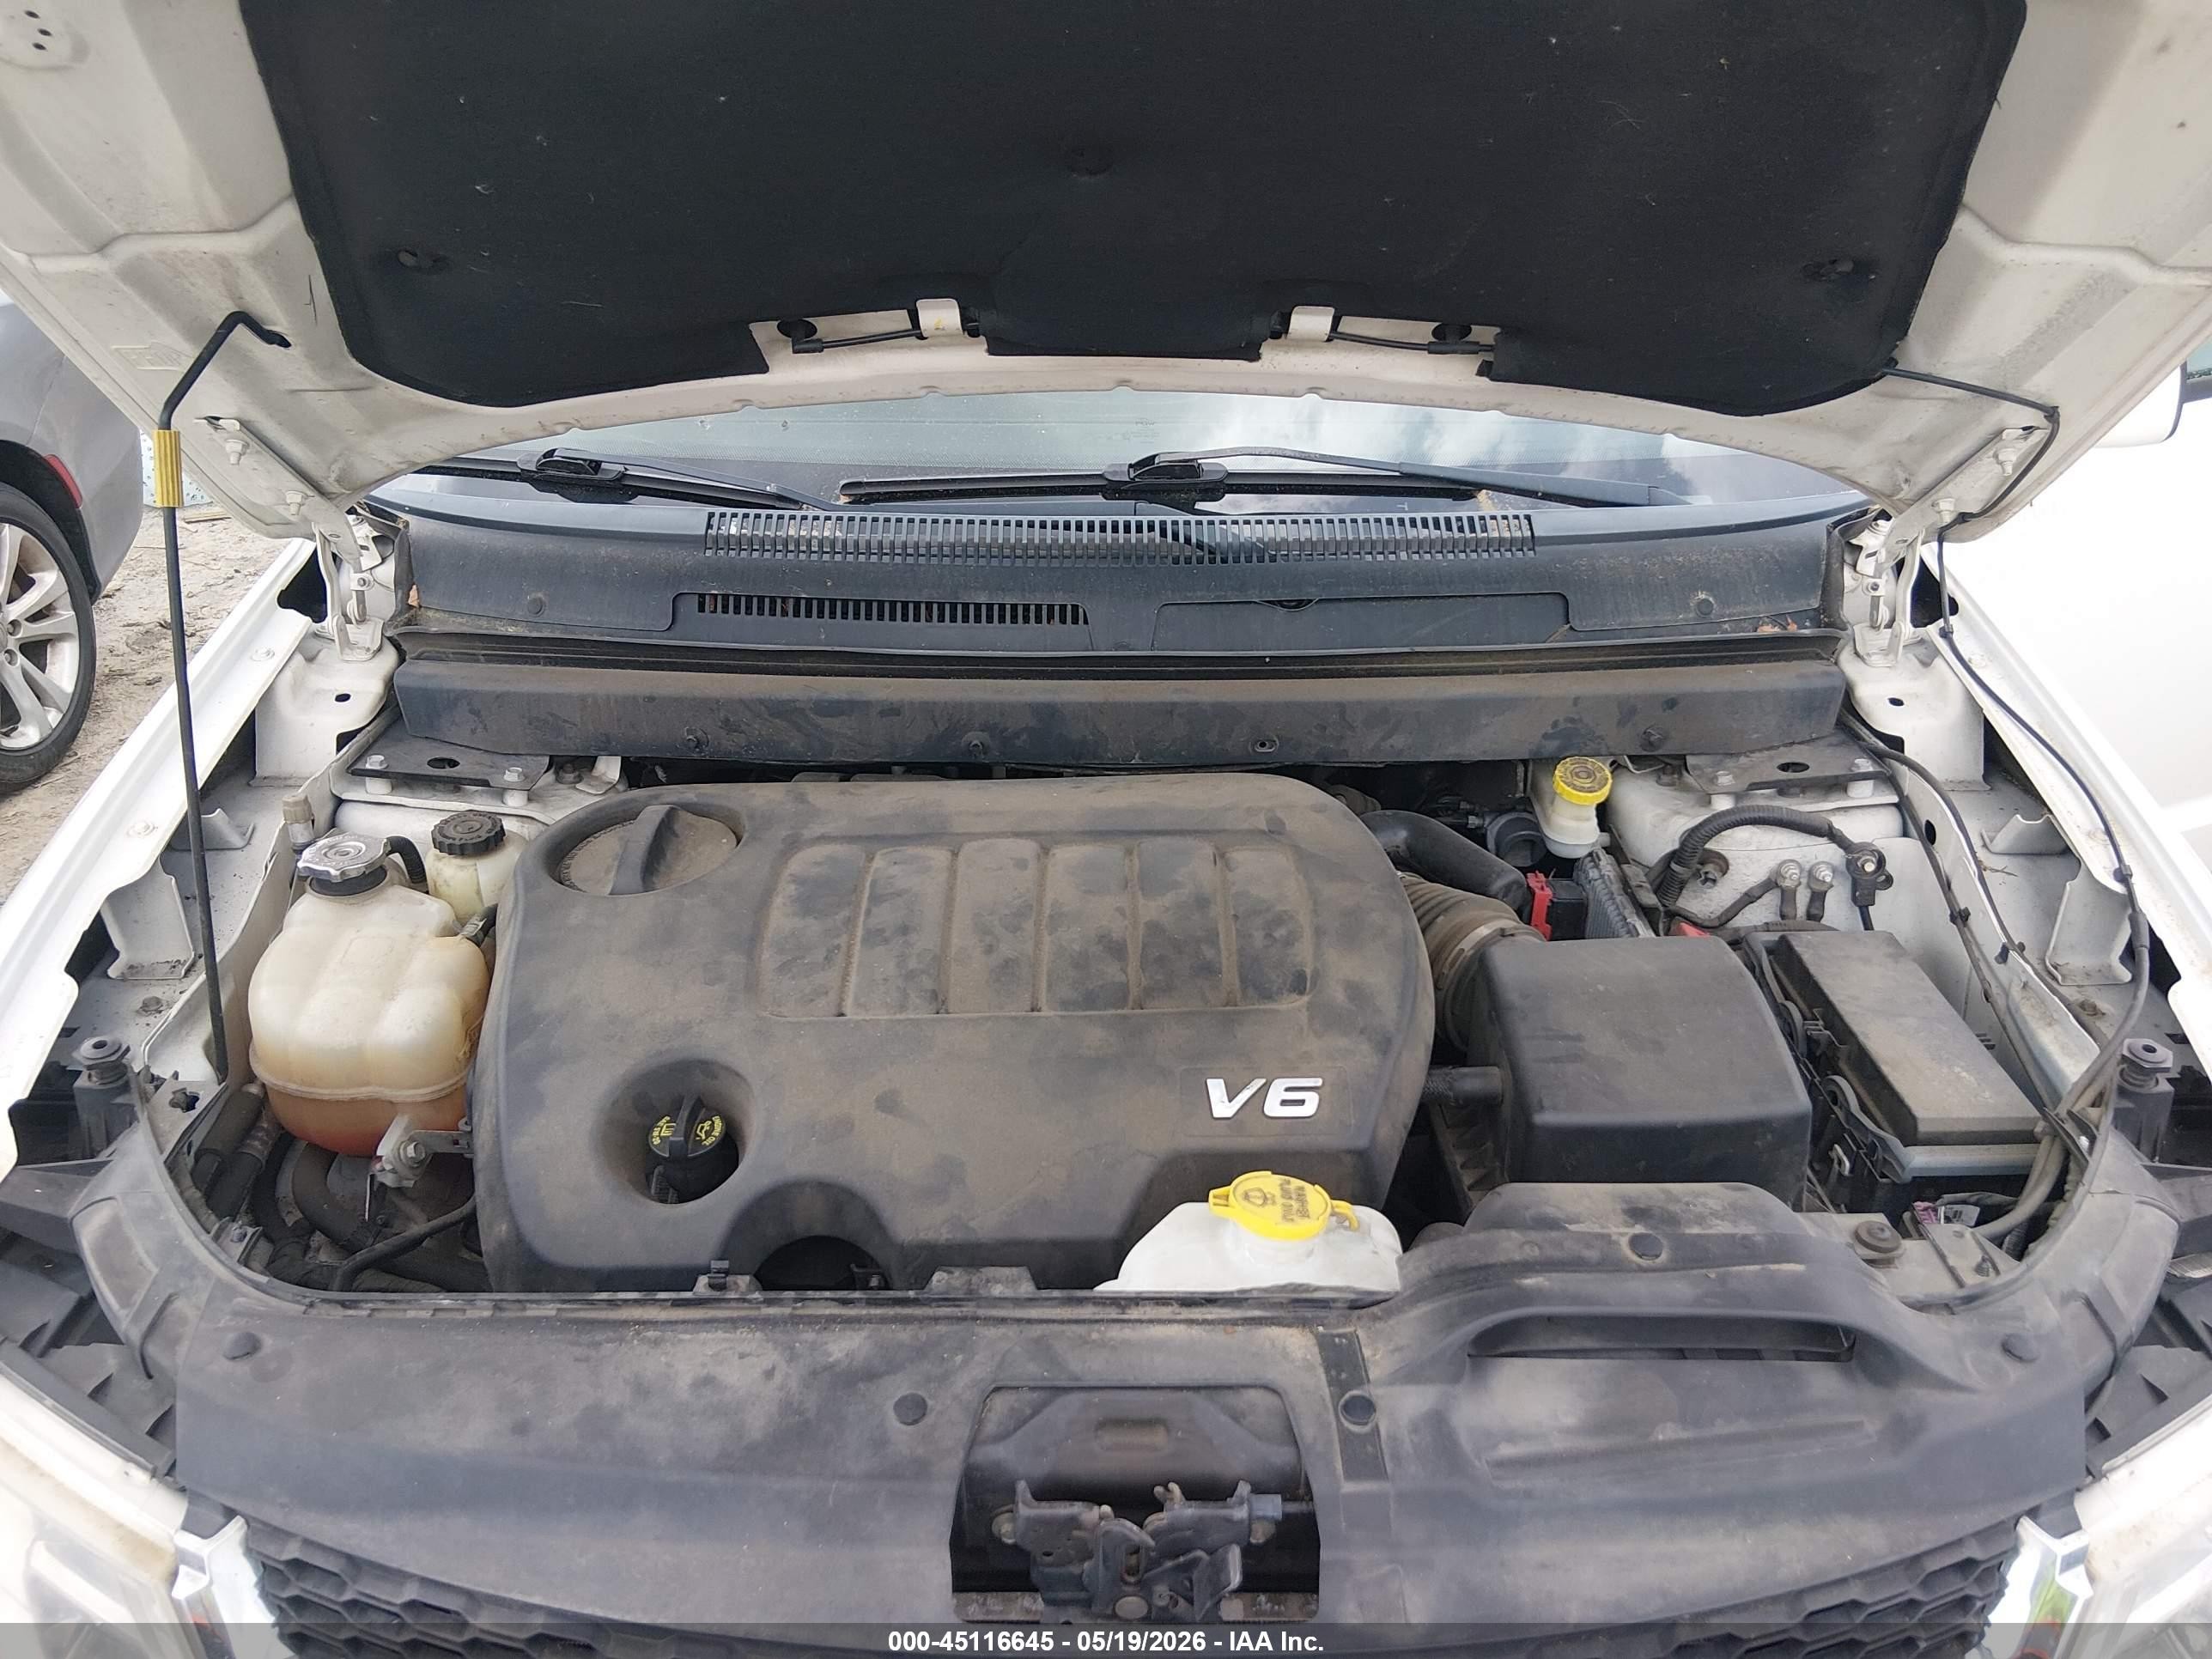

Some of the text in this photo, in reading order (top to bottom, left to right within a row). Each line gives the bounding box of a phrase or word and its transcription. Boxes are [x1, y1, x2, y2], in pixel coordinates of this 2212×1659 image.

[1206, 1077, 1323, 1119] V6
[702, 1115, 722, 1146] ENGINE OIL
[1279, 1177, 1295, 1223] FLUID ONLY
